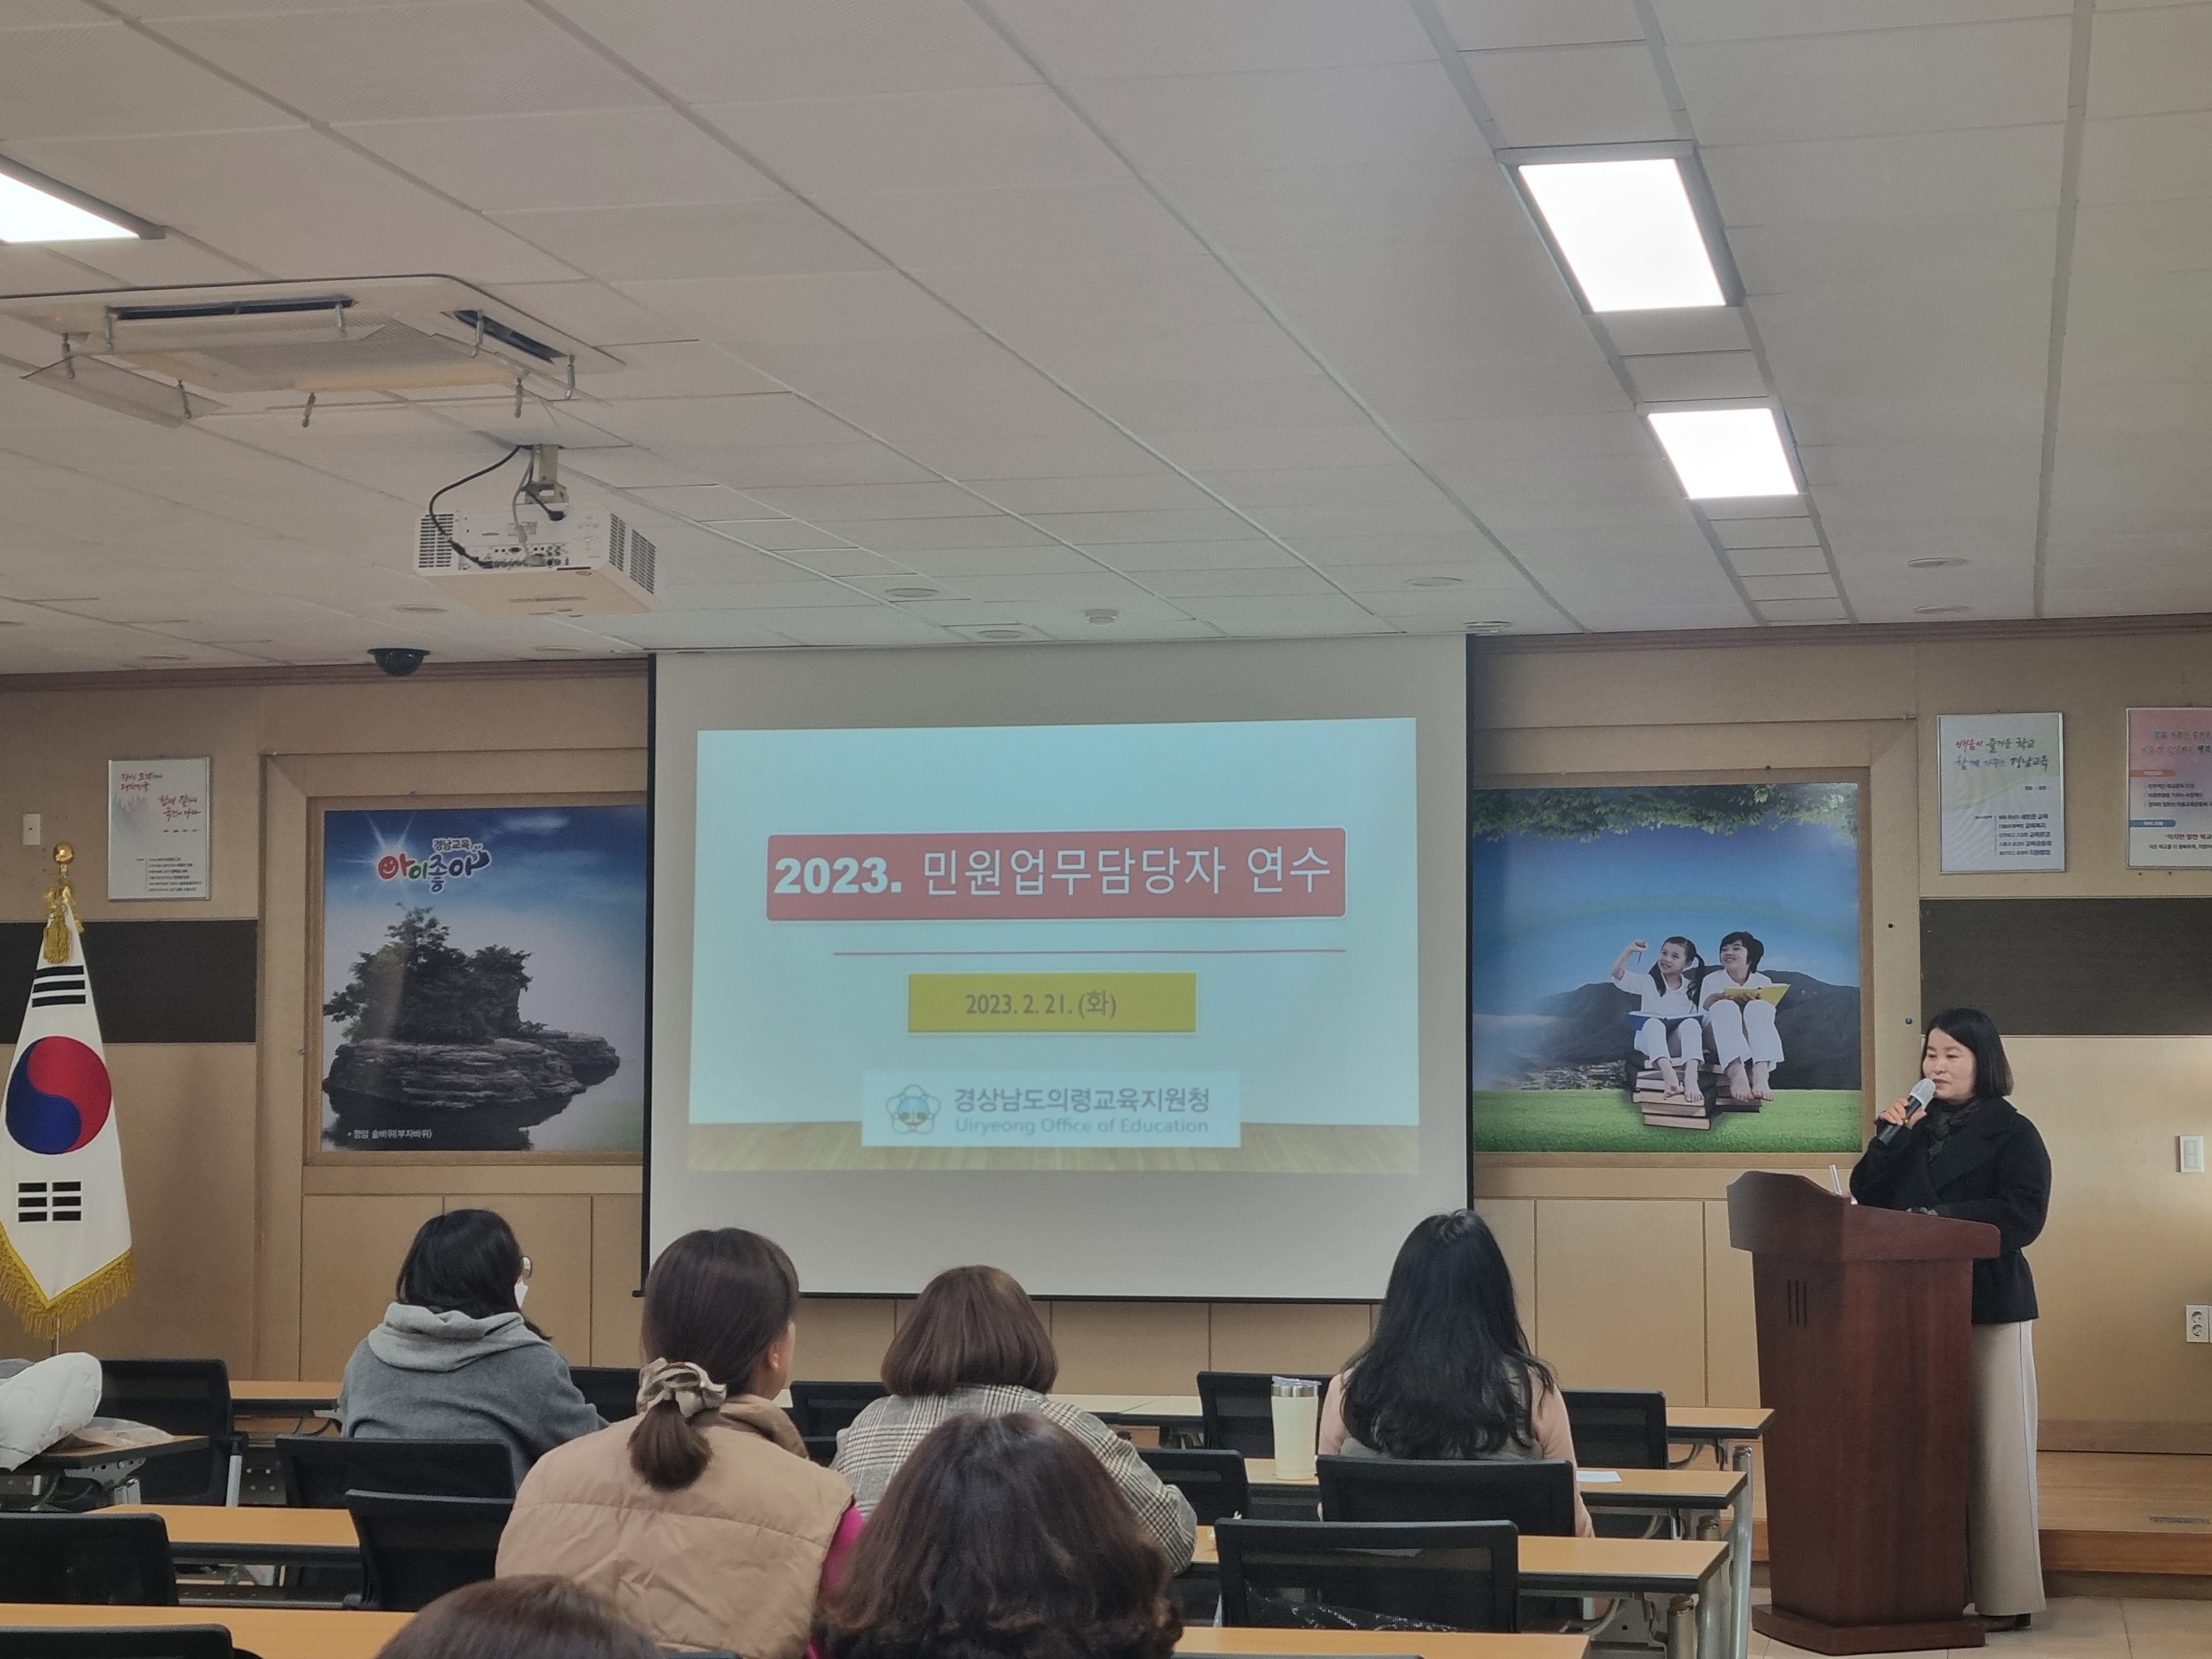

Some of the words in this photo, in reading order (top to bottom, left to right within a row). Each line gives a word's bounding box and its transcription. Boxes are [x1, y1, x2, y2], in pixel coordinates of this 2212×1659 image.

[1986, 737, 2013, 753] 즐거운
[2016, 736, 2035, 751] 학교
[1955, 755, 1980, 770] 함께
[2010, 755, 2049, 771] 경남교육
[434, 839, 470, 850] 경남교육
[377, 851, 490, 893] 아이좋아
[774, 857, 901, 894] 2023.
[924, 847, 1226, 895] 민원업무담당자
[1247, 846, 1330, 894] 연수
[955, 1087, 1210, 1113] 경상남도의령교육지원청
[955, 1117, 1036, 1136] Uiryeong
[1042, 1117, 1093, 1132] Office
[1098, 1117, 1116, 1132] of
[1121, 1117, 1209, 1132] Education
